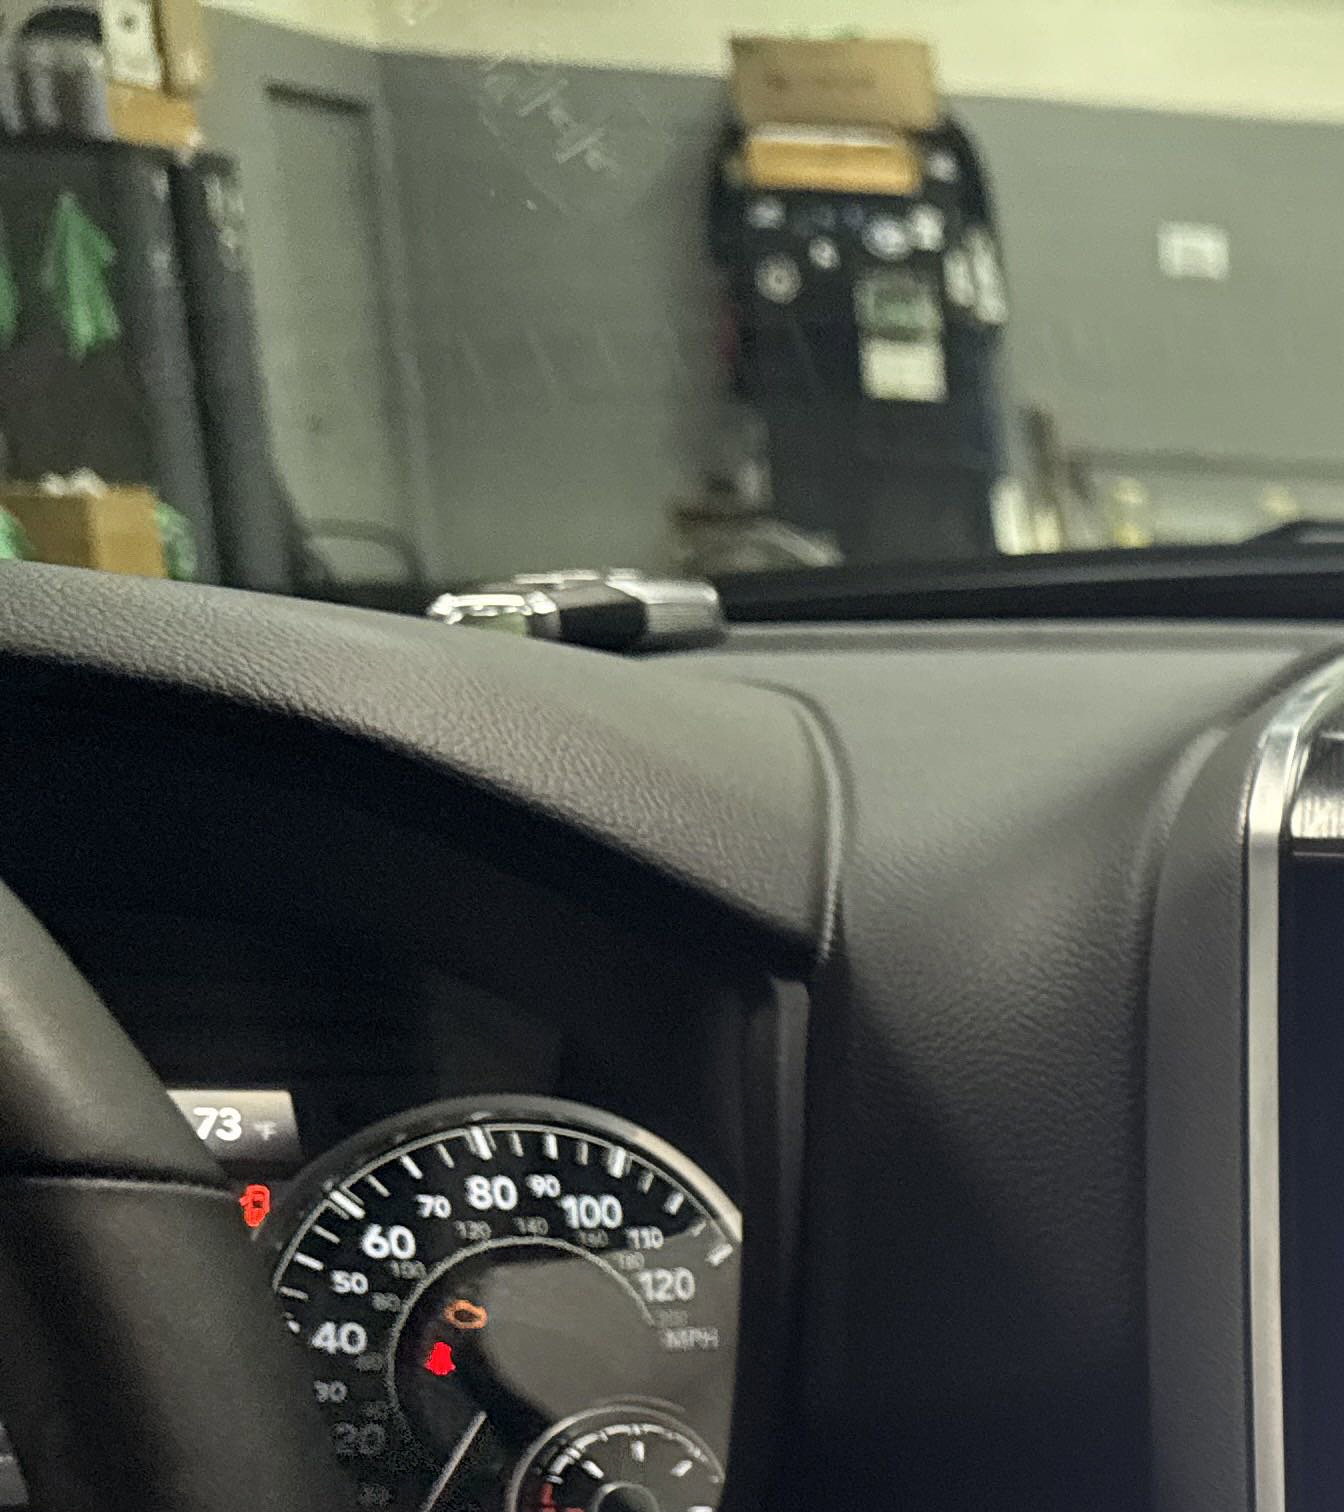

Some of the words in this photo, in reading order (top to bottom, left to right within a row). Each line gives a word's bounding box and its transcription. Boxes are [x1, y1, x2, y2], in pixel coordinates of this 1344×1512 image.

[193, 1106, 243, 1141] 73
[464, 1174, 519, 1211] 80
[525, 1173, 562, 1198] 90
[415, 1194, 452, 1219] 70
[556, 1194, 624, 1230] 100
[361, 1223, 417, 1260] 60
[625, 1226, 665, 1249] 110
[330, 1269, 369, 1295] 50
[637, 1266, 696, 1302] 120
[310, 1321, 369, 1355] 40
